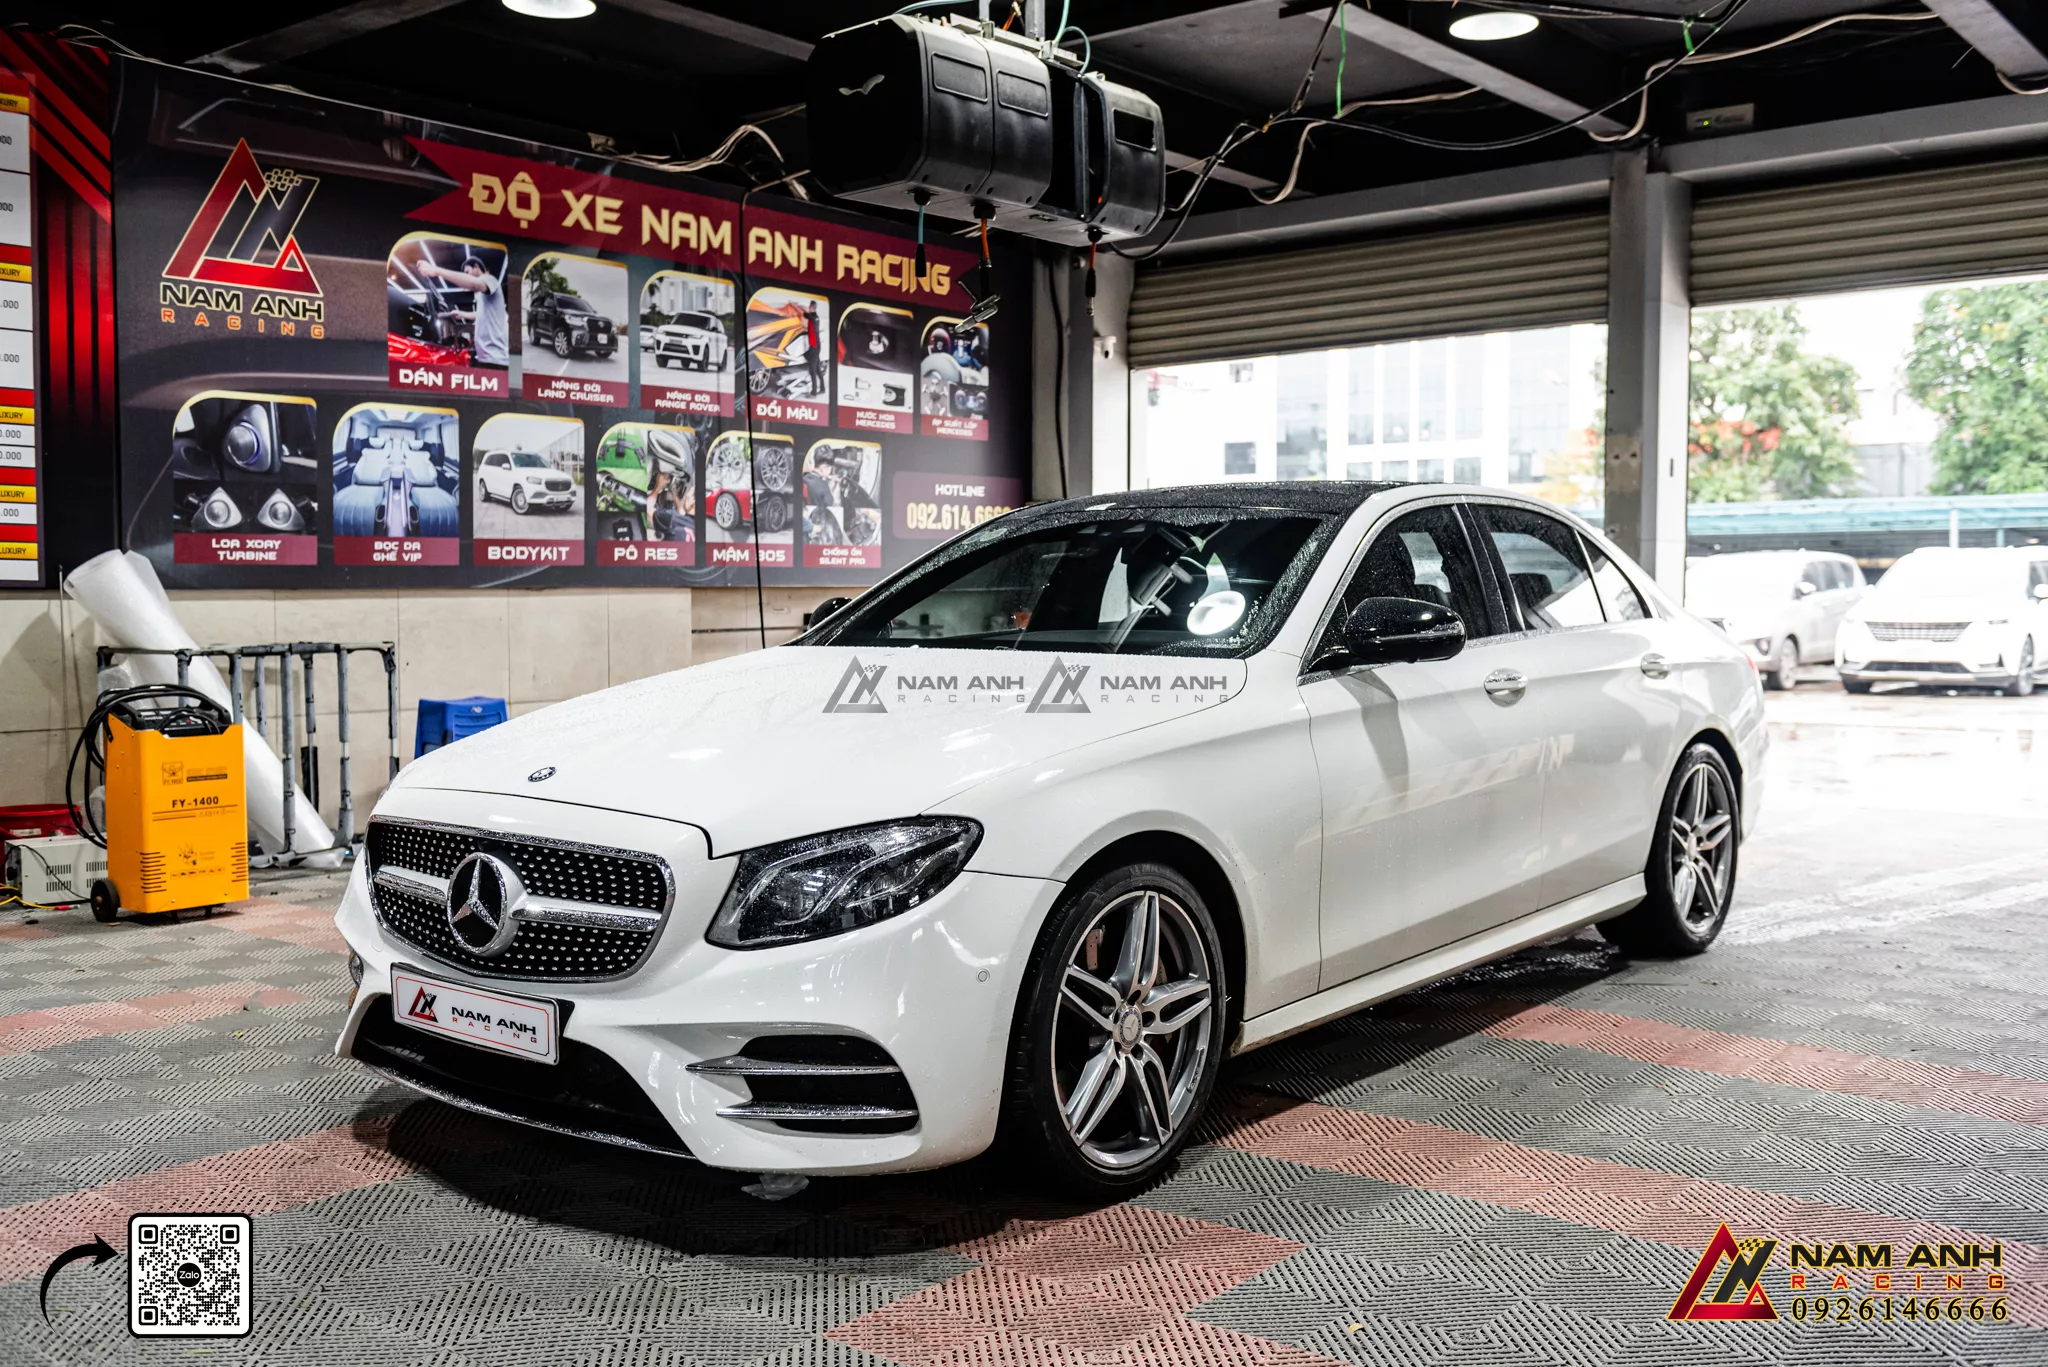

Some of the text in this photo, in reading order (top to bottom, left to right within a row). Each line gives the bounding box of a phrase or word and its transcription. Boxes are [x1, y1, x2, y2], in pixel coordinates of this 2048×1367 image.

[468, 171, 951, 296] ĐỘ XE NAM ANH RACING
[160, 281, 325, 323] NAM ANH
[161, 307, 325, 340] RACING
[399, 367, 498, 392] DÁN FILM
[537, 388, 614, 403] LAND CRUISER
[655, 398, 720, 413] RANGE ROVER
[855, 418, 896, 430] MERCEDES
[934, 483, 986, 498] HOTLINE
[212, 538, 282, 550] LOA XOAY
[403, 541, 421, 551] DA
[217, 550, 278, 562] TURBINE
[402, 552, 422, 562] VIP
[487, 546, 571, 561] BODYKIT
[614, 544, 679, 562] PÔ RES
[712, 546, 750, 563] MÂM
[819, 556, 866, 565] SILENT PRO
[171, 796, 219, 809] FY-1400
[451, 1006, 537, 1036] NAM ANH
[452, 1016, 538, 1044] RACING
